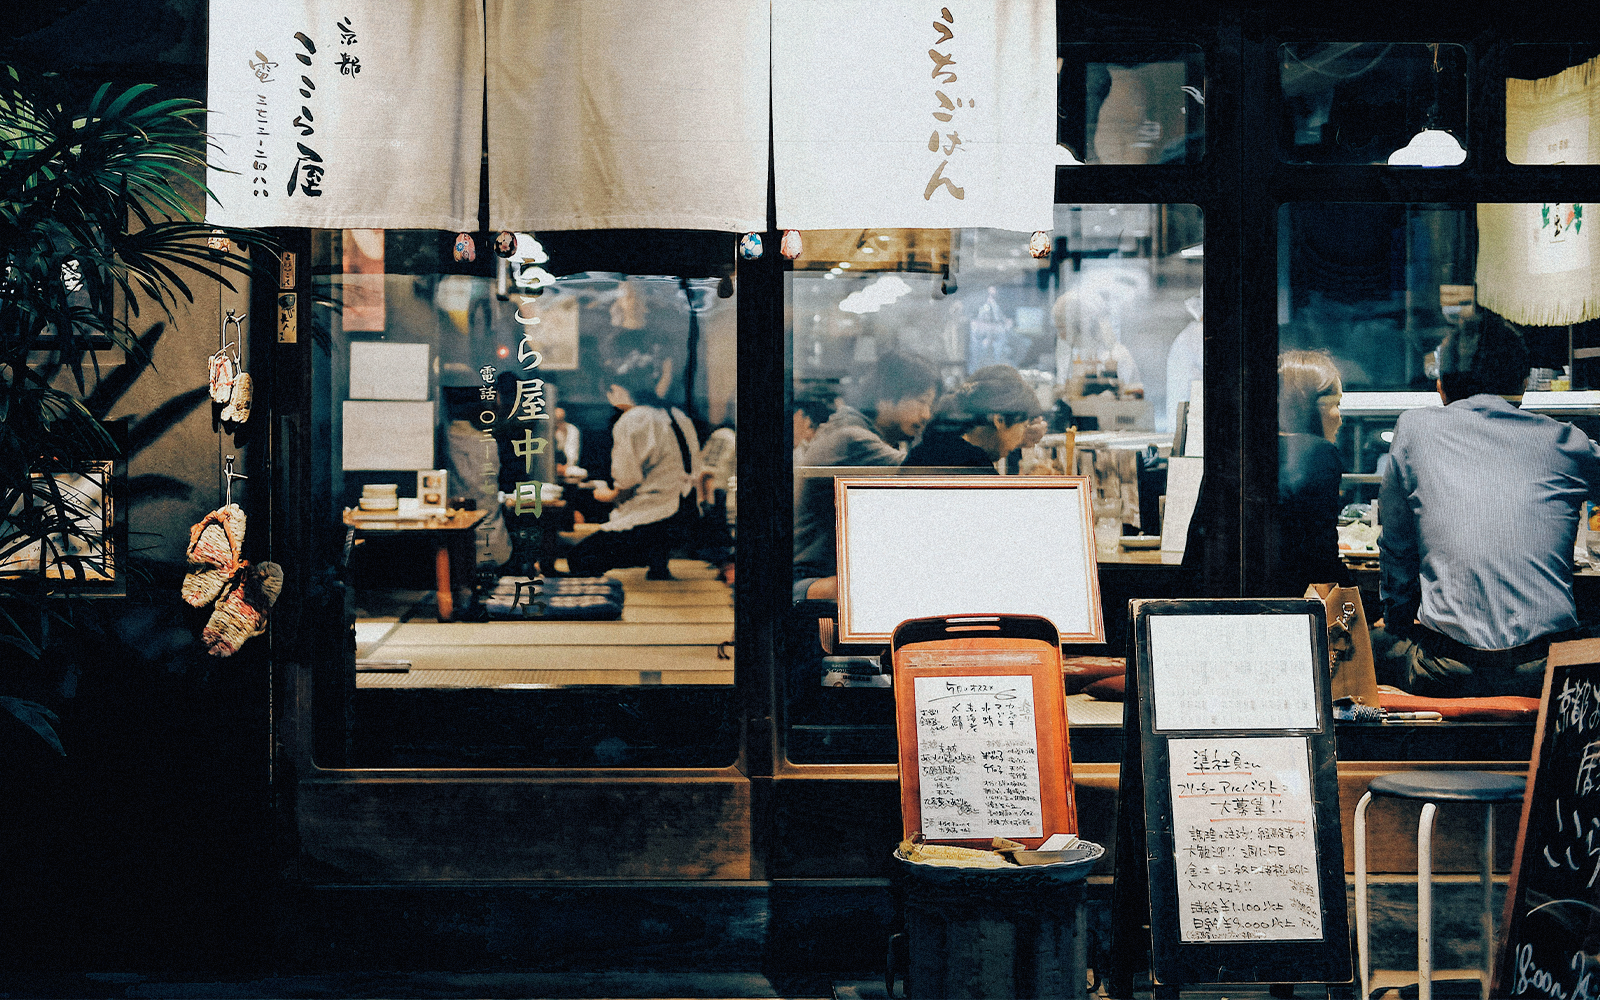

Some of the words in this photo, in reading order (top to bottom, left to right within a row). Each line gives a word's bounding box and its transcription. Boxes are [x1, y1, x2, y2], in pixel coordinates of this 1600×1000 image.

[334, 16, 361, 79] 京都
[924, 7, 975, 201] うちごはん
